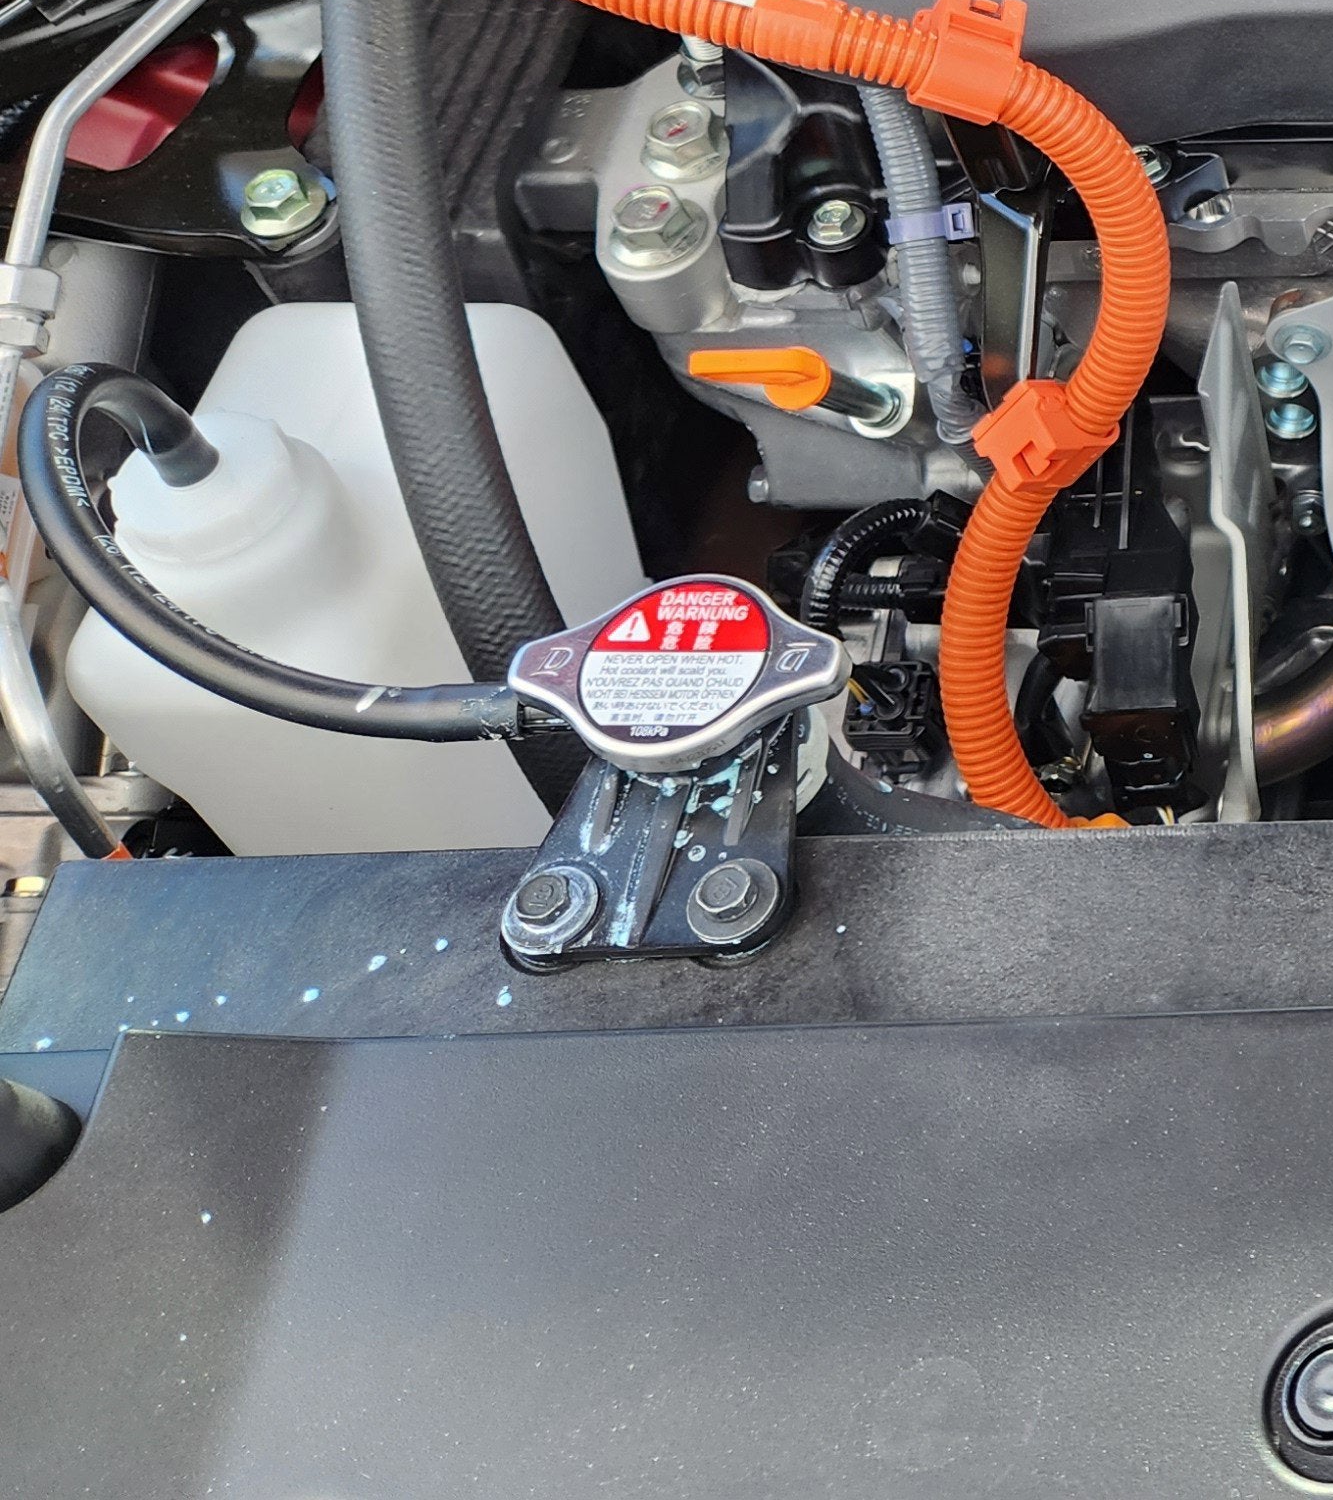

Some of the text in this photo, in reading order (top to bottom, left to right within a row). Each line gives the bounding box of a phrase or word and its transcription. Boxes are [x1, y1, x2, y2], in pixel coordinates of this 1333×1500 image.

[660, 591, 738, 606] DANGER
[657, 606, 750, 621] WARNUNG
[604, 655, 743, 665] NEVER OPEN WHEN HOT.
[601, 666, 619, 675] Hot
[621, 666, 659, 675] coolant
[660, 666, 677, 675] will
[678, 666, 706, 675] scald
[585, 677, 638, 688] N'OUVREZ
[642, 677, 663, 688] PAS
[665, 677, 704, 688] QUAND
[585, 689, 612, 699] NICHT
[612, 689, 628, 699] BEI
[629, 689, 667, 699] HEISSEM
[669, 689, 700, 699] MOTOR
[629, 725, 670, 737] 108kPa
